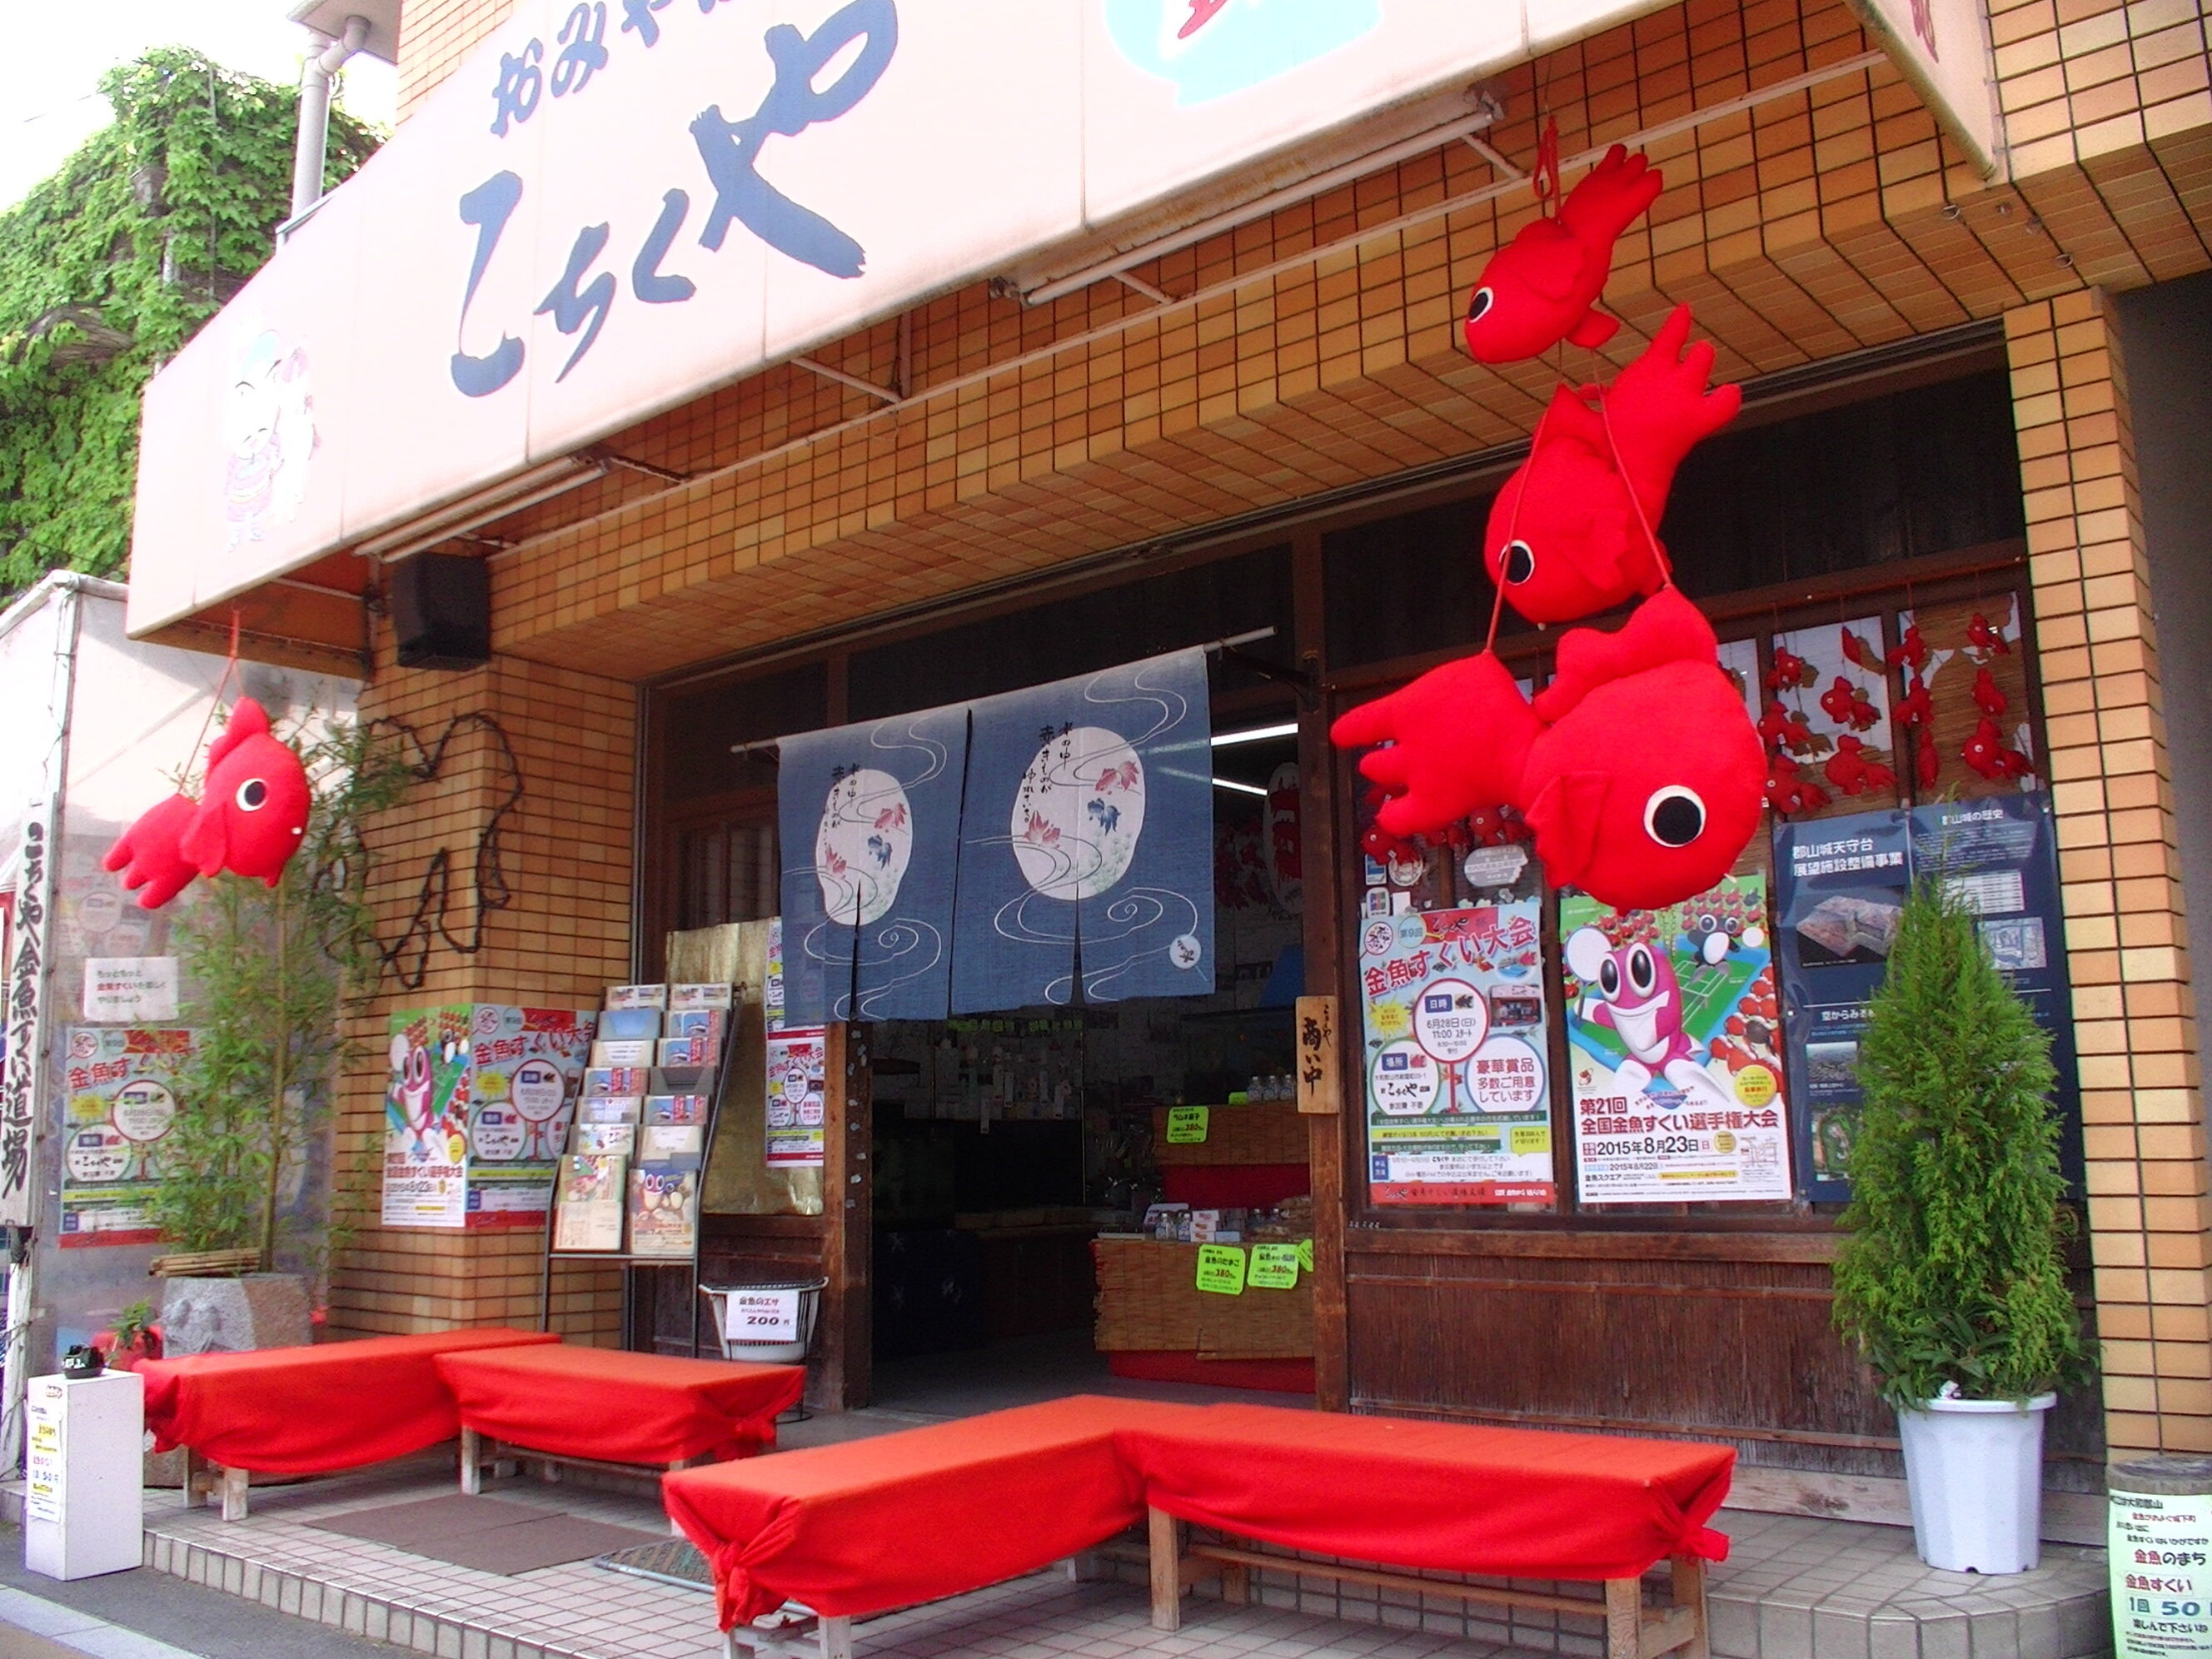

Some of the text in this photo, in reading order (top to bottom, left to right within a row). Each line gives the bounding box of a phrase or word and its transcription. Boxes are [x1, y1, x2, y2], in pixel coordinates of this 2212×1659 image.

[490, 0, 733, 138] おみや
[451, 0, 899, 397] こちくや
[1793, 838, 1874, 859] 郡山城天守台
[1793, 851, 1903, 877] 展望施設整備事業
[1400, 927, 1422, 938] 第9回
[1364, 916, 1537, 997] 金魚すくい大会
[1430, 999, 1447, 1009] 日時
[1303, 1017, 1323, 1097] 商い中
[1477, 1058, 1534, 1074] 豪華賞品
[1477, 1076, 1535, 1090] 多数ご用意
[1479, 1090, 1534, 1104] しています
[1580, 1096, 1627, 1115] 第21回
[1582, 1109, 1779, 1135] 全国金魚すくい選手権大会
[1597, 1135, 1698, 1156] 2015年8月23日
[747, 1317, 779, 1325] 200
[2135, 1549, 2206, 1566] 金魚のまち
[2125, 1574, 2192, 1592] 金魚すくい
